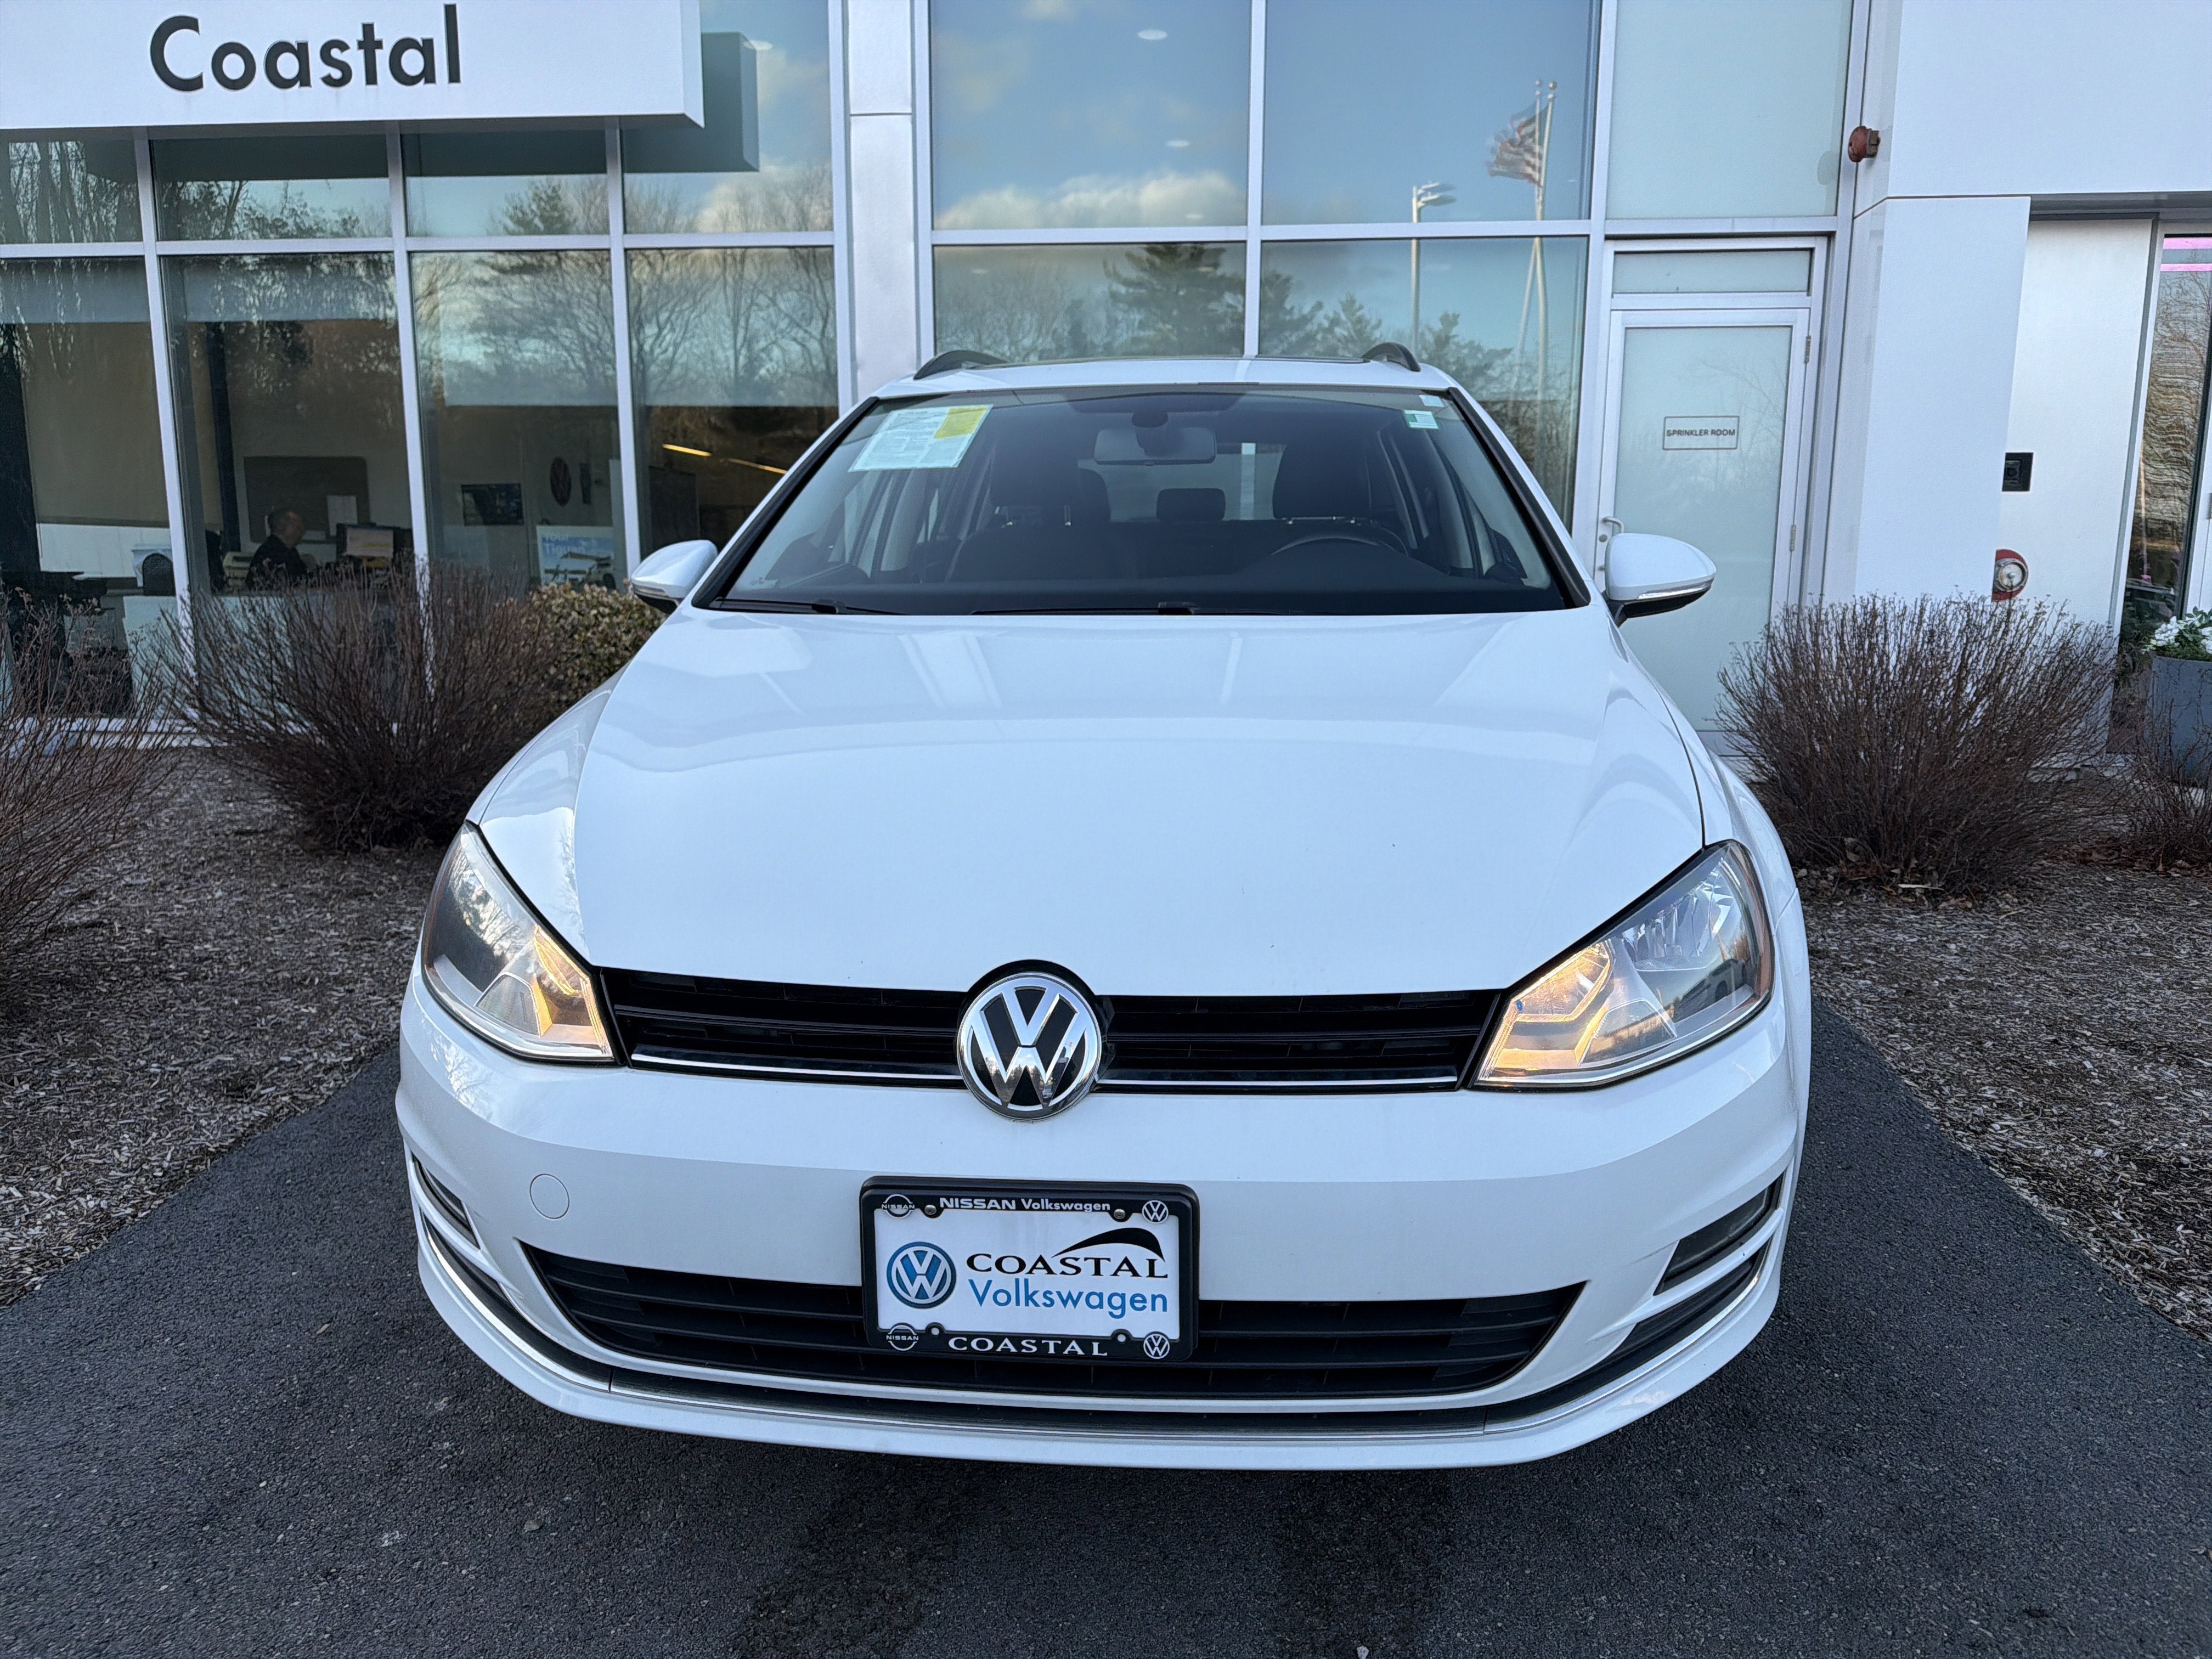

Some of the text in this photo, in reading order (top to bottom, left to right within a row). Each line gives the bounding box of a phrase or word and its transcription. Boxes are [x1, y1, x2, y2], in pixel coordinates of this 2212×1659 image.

[149, 3, 462, 92] Coastal
[961, 975, 1097, 1115] VW
[939, 1197, 1110, 1212] NISSAN Volkswagen
[1143, 1201, 1168, 1223] VW
[889, 1245, 955, 1306] VW
[966, 1253, 1169, 1279] COASTAL
[968, 1277, 1167, 1319] Volkswagen
[948, 1336, 1108, 1356] COASTAL
[1144, 1335, 1169, 1358] VW
